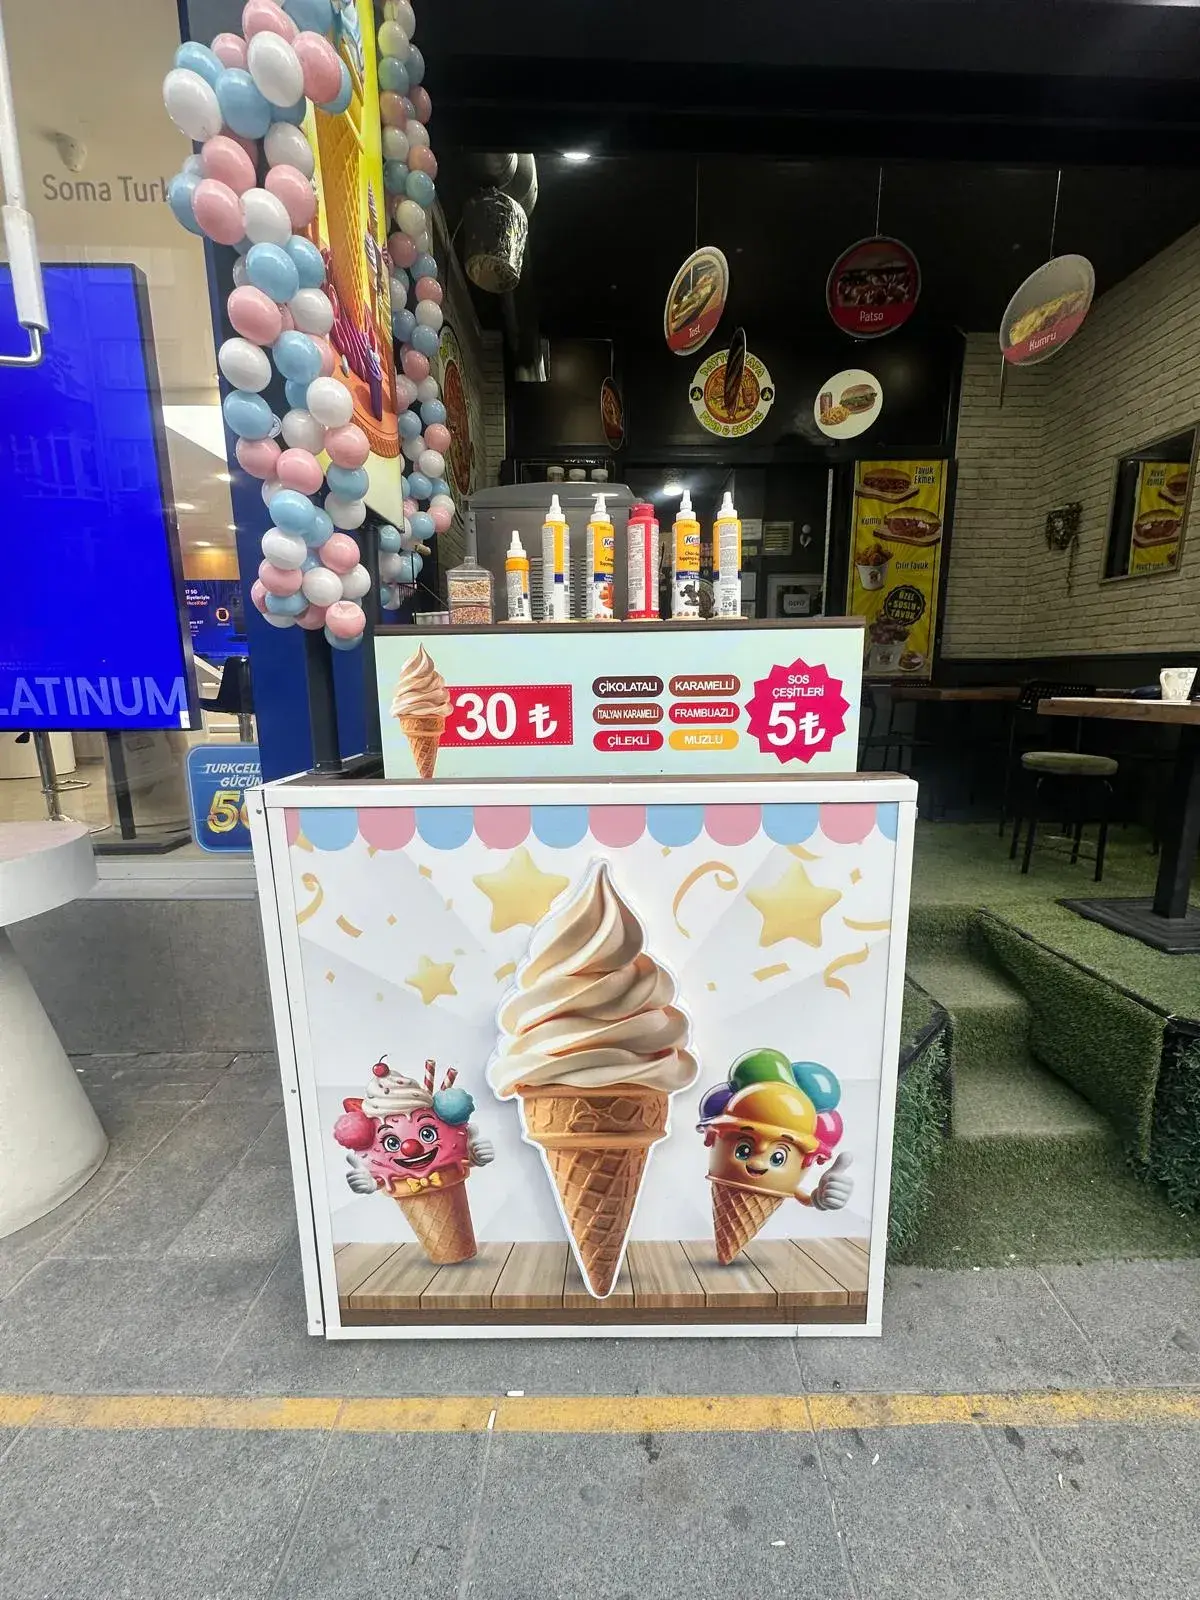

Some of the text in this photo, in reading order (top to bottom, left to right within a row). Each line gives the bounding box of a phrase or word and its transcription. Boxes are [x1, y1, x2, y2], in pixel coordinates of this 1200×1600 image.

[43, 174, 112, 201] Soma
[860, 310, 884, 322] Patso
[688, 324, 701, 338] Tost
[1028, 332, 1057, 351] Kumru
[675, 679, 734, 690] KARAMELLİ
[788, 675, 809, 684] SOS
[599, 680, 657, 694] ÇİKOLATALI
[772, 685, 824, 699] ÇEŞİTLERİ
[455, 692, 517, 740] 30
[597, 707, 659, 719] İTALYAN KARAMELLİ
[675, 708, 733, 718] FRAMBUAZLI
[608, 734, 649, 747] ÇİLEKLİ
[684, 735, 723, 745] MUZLU
[205, 763, 261, 774] TURKCELL
